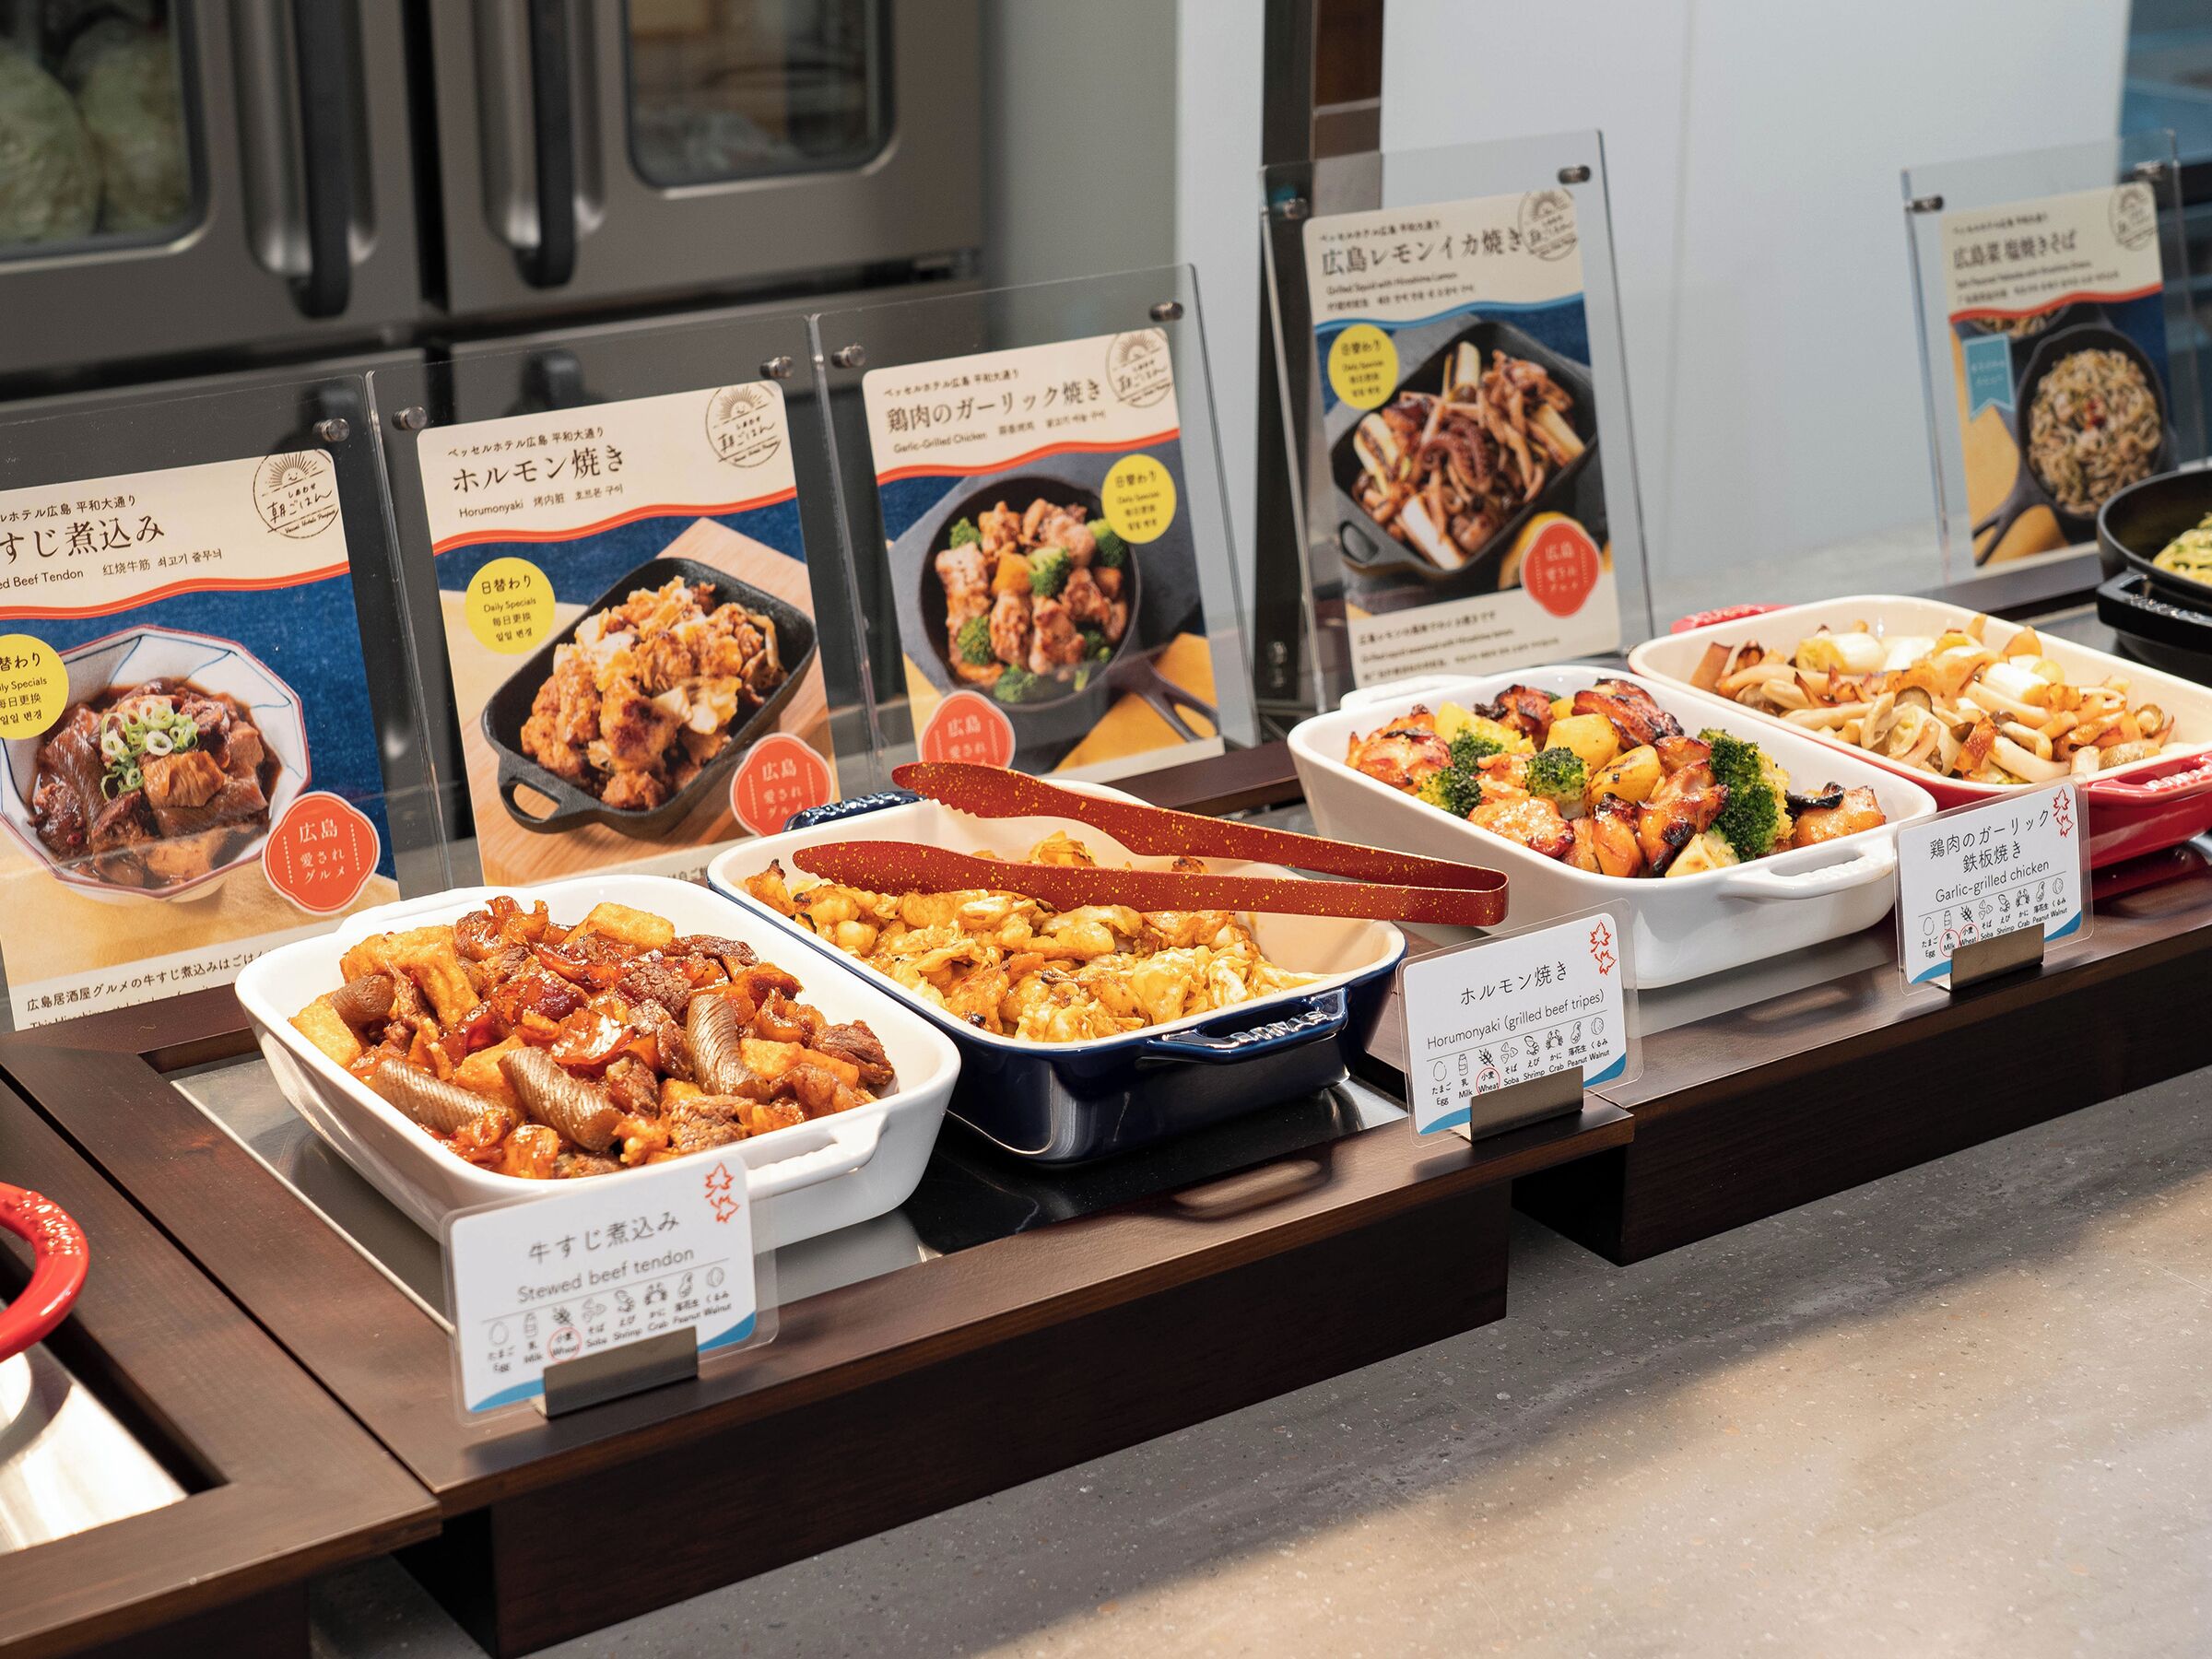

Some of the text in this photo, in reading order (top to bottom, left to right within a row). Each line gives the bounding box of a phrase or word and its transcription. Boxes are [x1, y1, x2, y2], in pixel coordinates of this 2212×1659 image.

[1322, 227, 1523, 276] 広島レモンイカ焼き
[887, 378, 1100, 434] 鶏肉のガーリック焼き
[453, 444, 624, 494] ホルモン焼き
[76, 495, 136, 513] 平和大通り
[459, 500, 524, 519] Horumonyaki
[13, 573, 39, 588] Beef
[41, 569, 84, 582] Tendon
[481, 574, 532, 595] 日替わり
[483, 597, 536, 613] Daily Specials
[11, 677, 47, 691] Specials
[947, 714, 981, 738] 広島
[762, 758, 796, 782] 広島
[763, 786, 803, 805] 愛され
[299, 818, 338, 844] 広島
[1930, 809, 2049, 860] 鶏肉のガーリック
[300, 848, 346, 868] 愛され
[305, 865, 346, 885] グルメ
[1962, 841, 2021, 874] 鉄板焼き
[1936, 861, 2050, 903] Garlic-grilled chicken
[1925, 907, 2067, 959] Egg Milk Wheat Soba Shrimp Crab Peanut Walnut
[1460, 960, 1568, 1006] ホルモン焼き
[1427, 988, 1605, 1050] Horumonyaki (grilled beef tripes)
[1431, 1038, 1608, 1095] たまご 乳 小麦 そば えび かに 落花生 くるみ
[1436, 1050, 1610, 1106] Egg Milk Wheat Soba Shrimp Crab Peanut Walnut
[528, 1211, 680, 1265] 牛すじ煮込み
[517, 1248, 694, 1304] Stewed beef tendon
[524, 1352, 543, 1363] Milk
[613, 1327, 642, 1341] Shrimp
[648, 1321, 669, 1331] Crab
[672, 1312, 701, 1324] Peanut
[703, 1303, 732, 1316] Walnut
